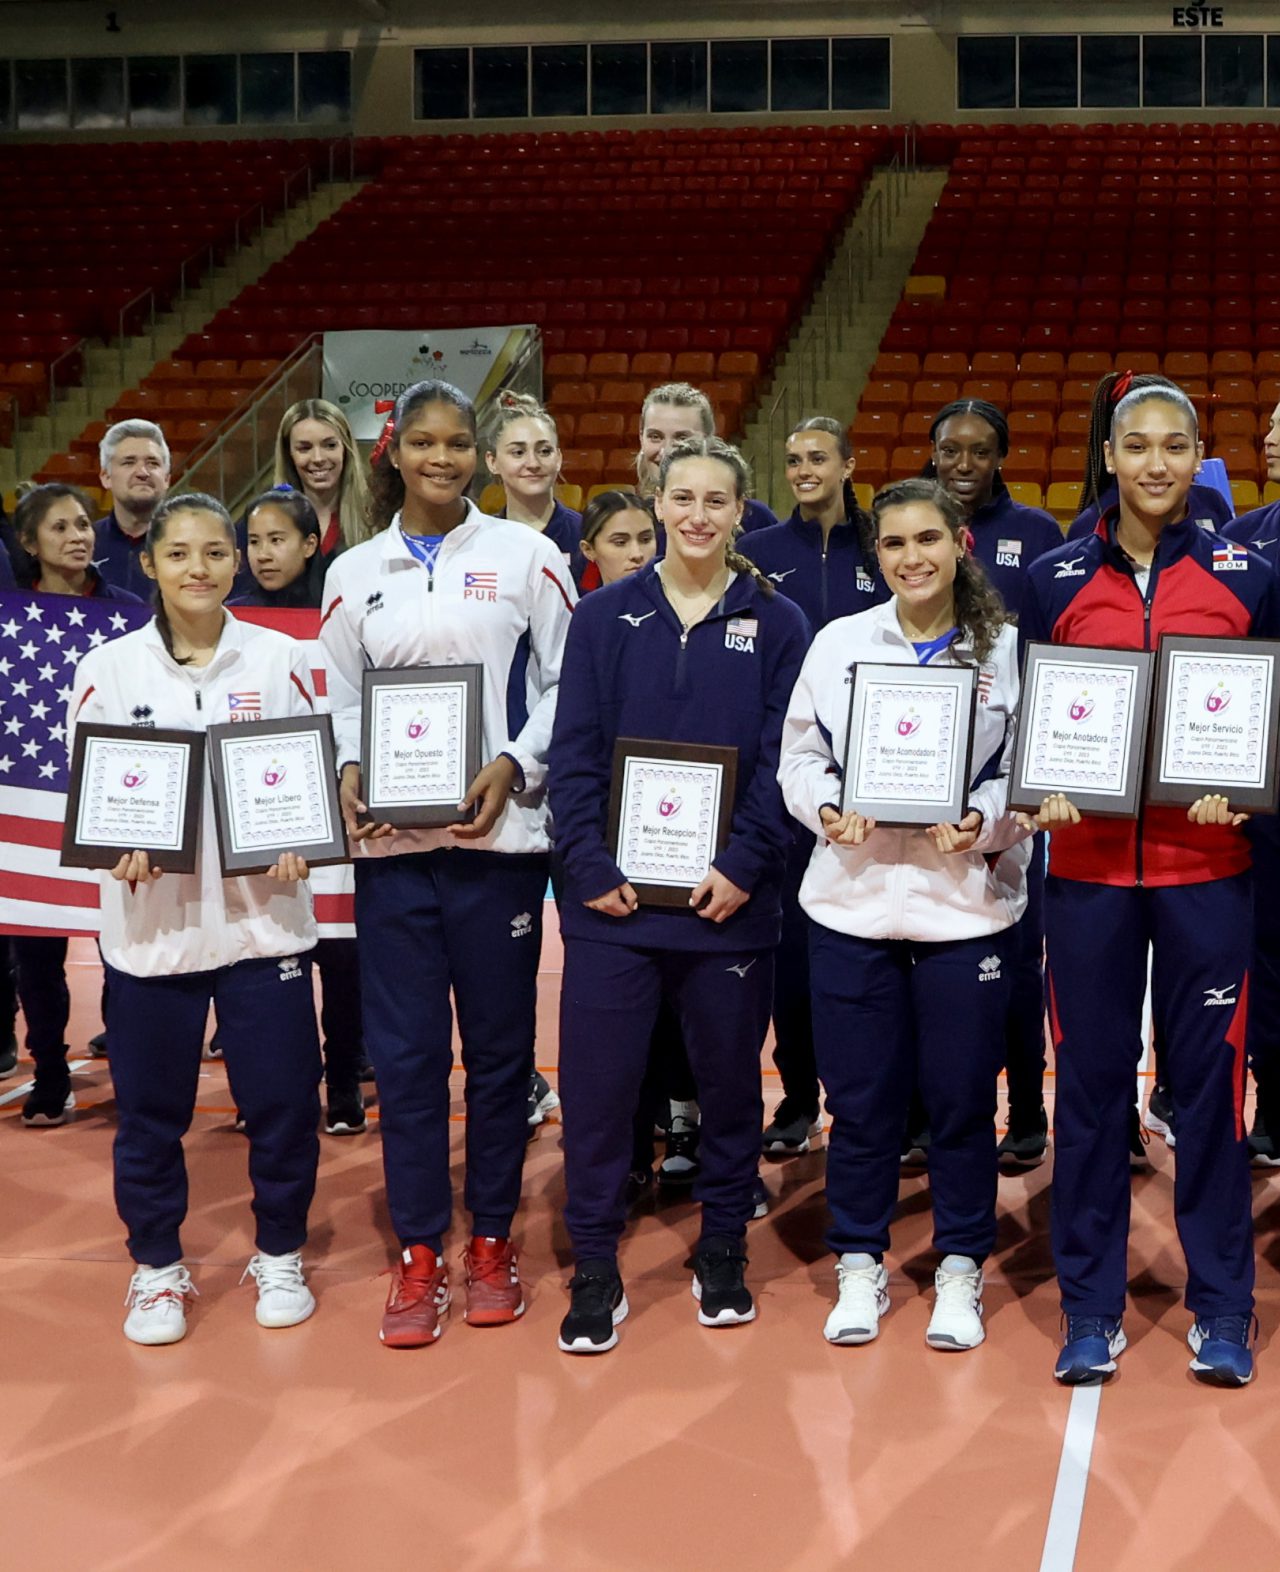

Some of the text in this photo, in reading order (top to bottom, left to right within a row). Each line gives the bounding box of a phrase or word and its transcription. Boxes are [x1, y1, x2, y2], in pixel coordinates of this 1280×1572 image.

[1173, 7, 1223, 27] ESTE
[995, 552, 1020, 568] USA
[463, 590, 497, 602] PUR
[724, 633, 755, 654] USA
[1188, 722, 1244, 734] Mejor Servicio
[1053, 730, 1108, 743] Mejor Anotadora
[394, 749, 443, 760] Mejor Opuesto
[880, 746, 896, 757] Mejor
[107, 796, 160, 807] Mejor Defensa
[254, 796, 275, 807] Mejor
[642, 825, 697, 838] Mejor Recepcion
